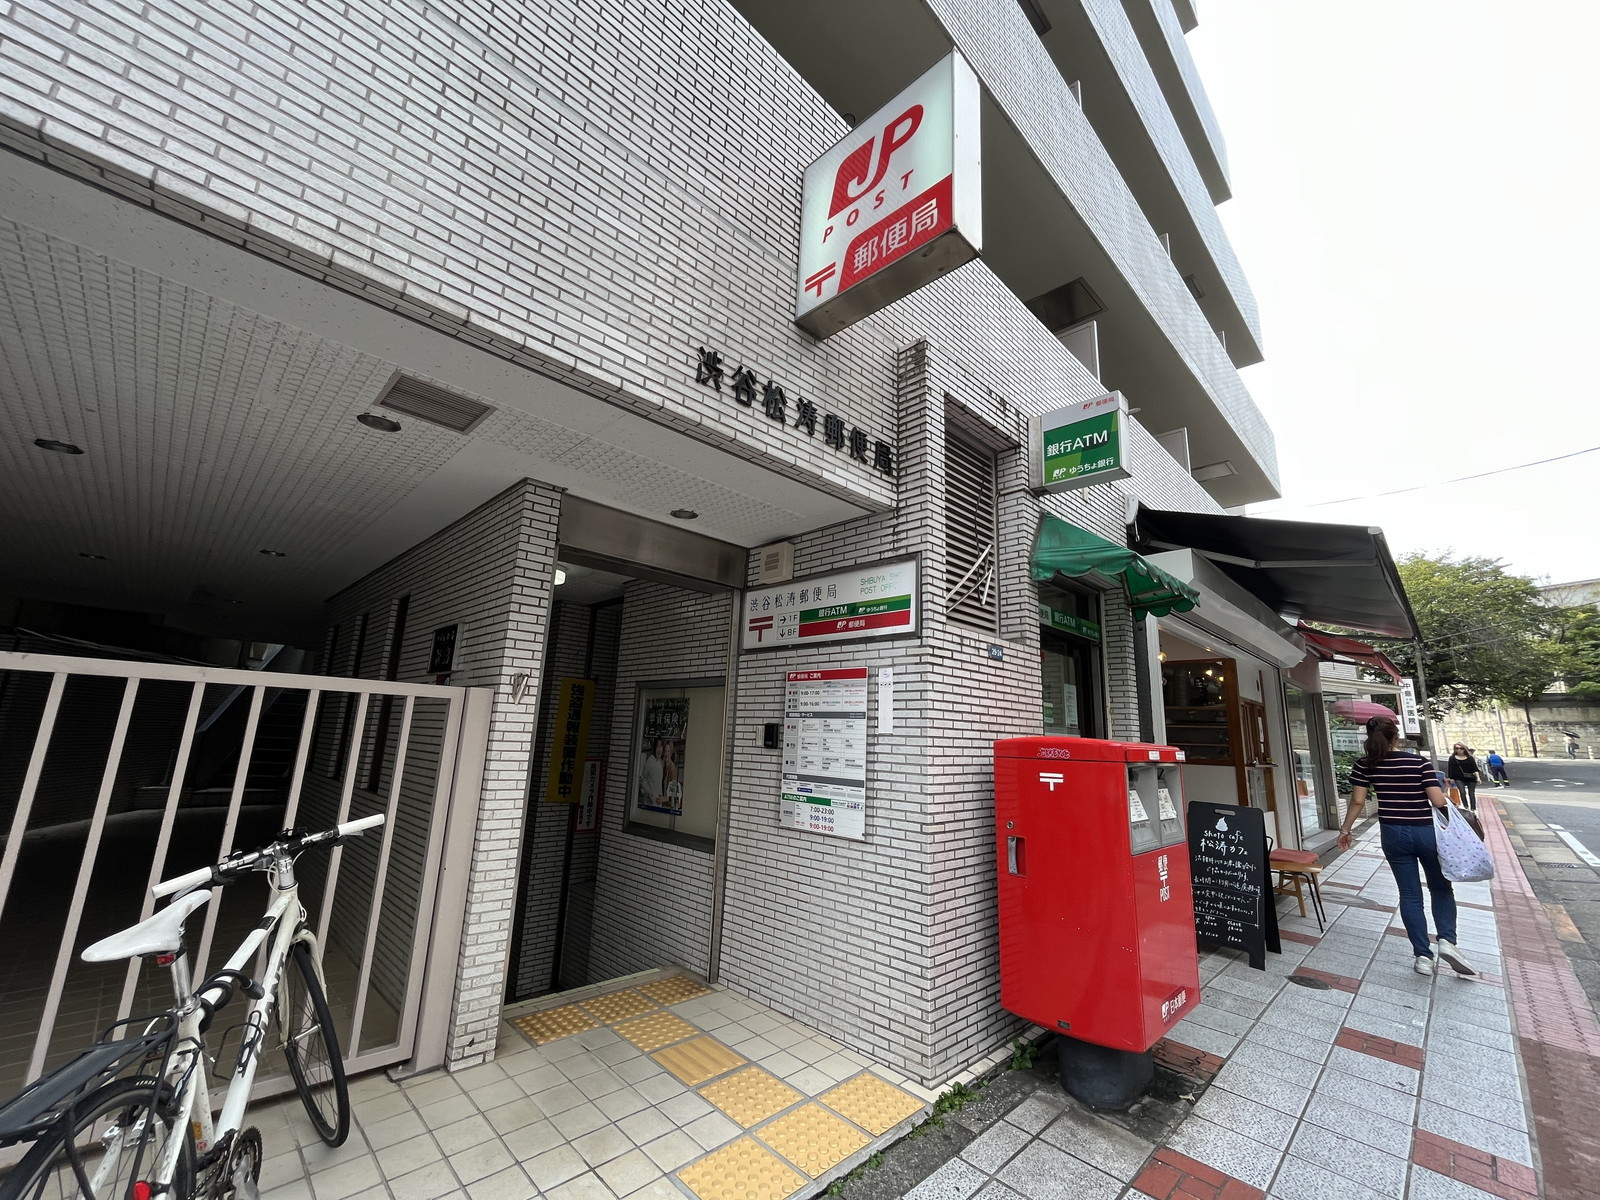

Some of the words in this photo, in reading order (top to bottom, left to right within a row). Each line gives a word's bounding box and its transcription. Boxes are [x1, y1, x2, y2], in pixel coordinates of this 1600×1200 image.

[828, 104, 924, 220] JP
[823, 169, 914, 243] POST
[853, 198, 938, 274] 郵便局
[1046, 430, 1108, 457] 銀行ATM
[1069, 457, 1114, 474] ゆうちょ銀行
[860, 575, 885, 586] SHIBUYA
[860, 585, 876, 594] POST
[789, 613, 798, 622] 1F
[818, 605, 848, 618] 銀行ATM
[848, 619, 865, 629] 郵便局
[1228, 830, 1244, 844] cafe
